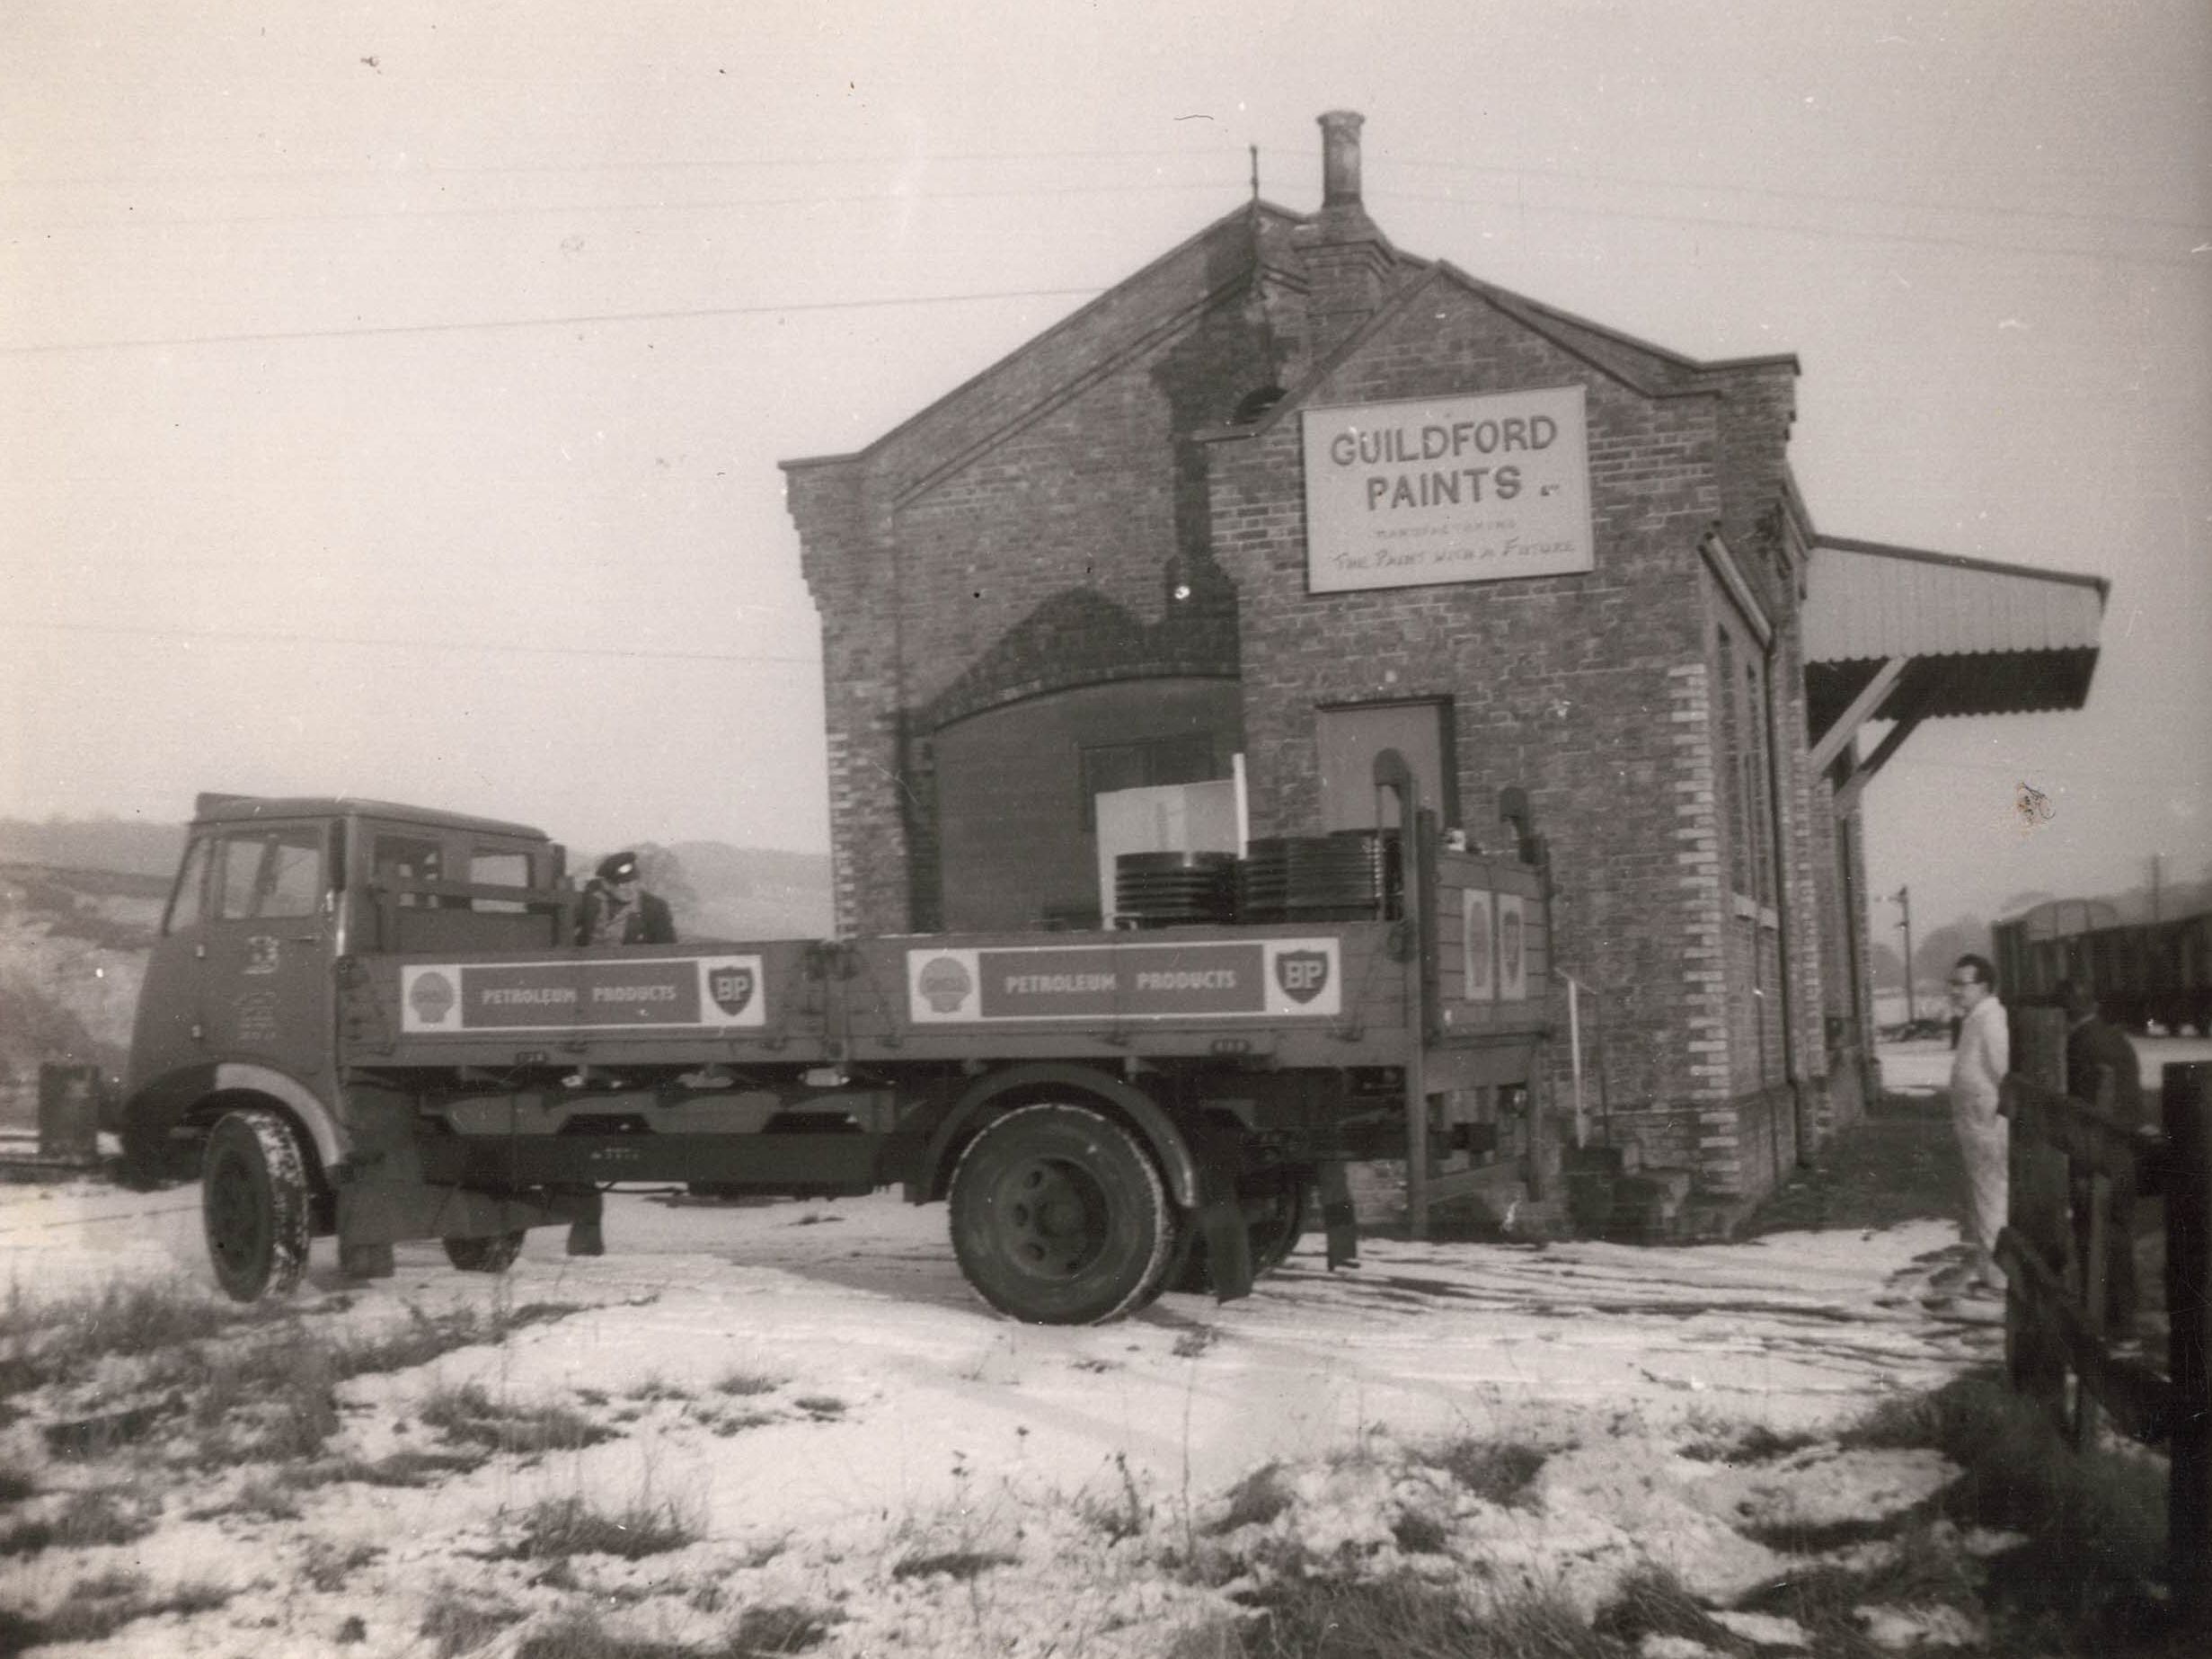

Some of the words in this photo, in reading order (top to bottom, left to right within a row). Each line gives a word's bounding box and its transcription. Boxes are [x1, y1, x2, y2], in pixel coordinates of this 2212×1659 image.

[1331, 415, 1557, 466] GUILDFORD
[1367, 465, 1522, 510] PAINTS
[1005, 972, 1117, 994] PETROLEUM
[1136, 969, 1237, 990] PRODUCTS
[1283, 959, 1324, 989] BP
[481, 989, 577, 1006] PETROLEUM
[591, 985, 677, 1003] PRODUCTS
[718, 975, 749, 1002] BP
